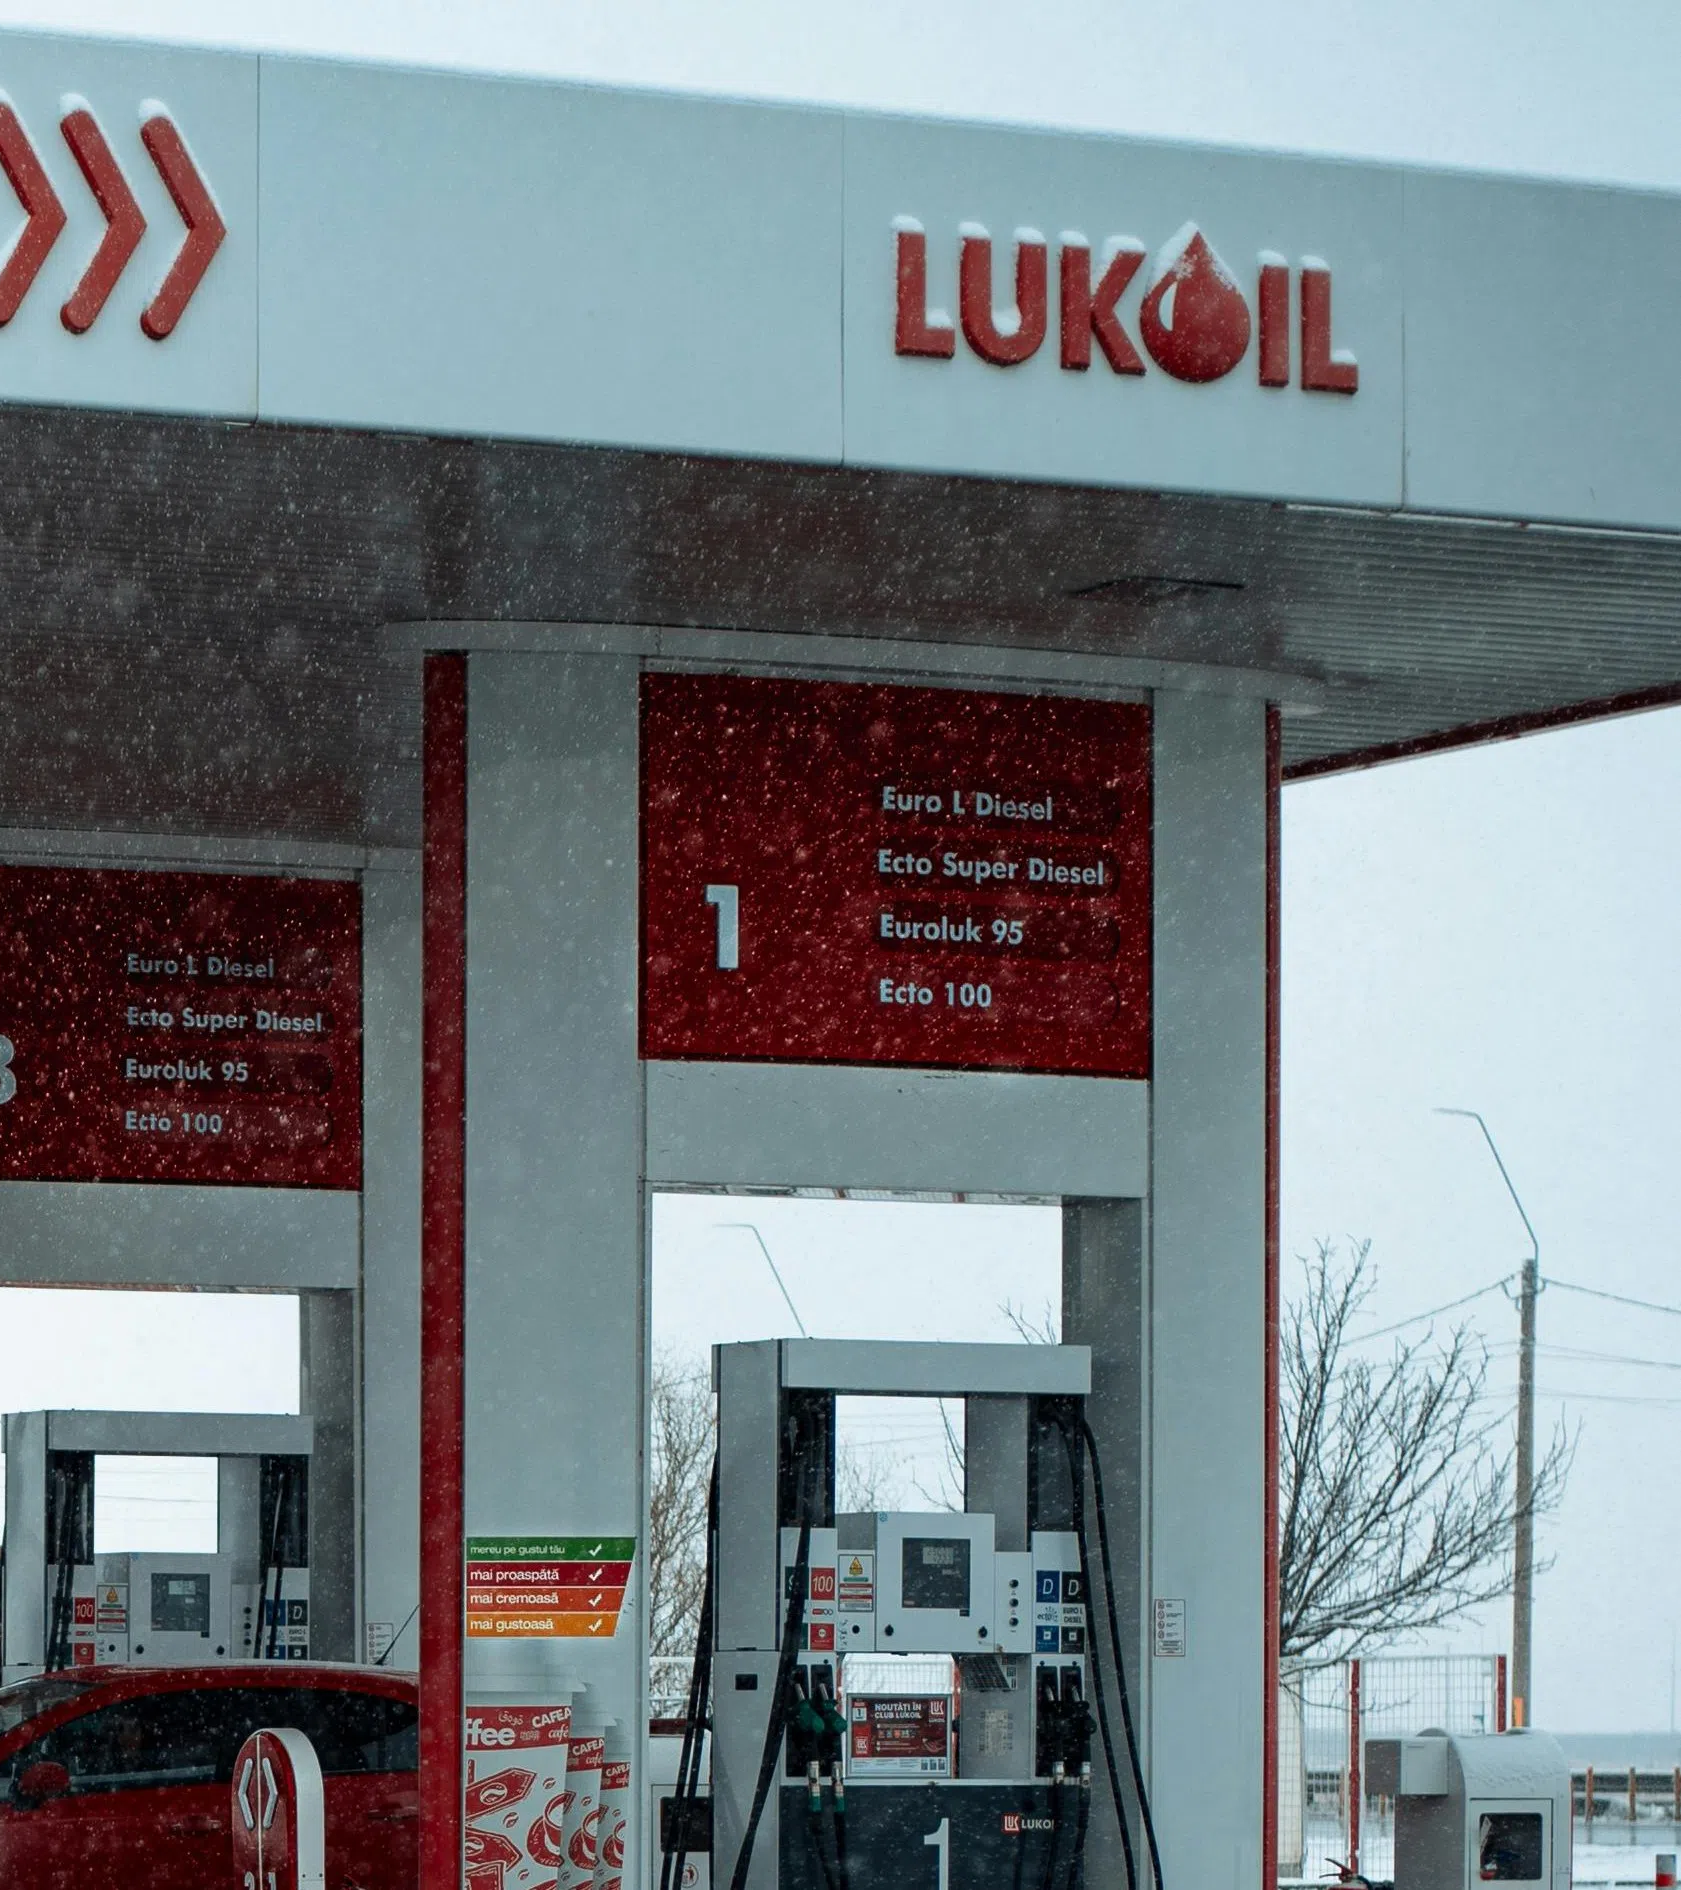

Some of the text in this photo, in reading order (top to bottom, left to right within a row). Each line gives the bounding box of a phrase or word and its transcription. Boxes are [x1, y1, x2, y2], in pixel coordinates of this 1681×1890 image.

[894, 217, 1359, 394] LUKOIL
[882, 786, 1054, 822] Euro L Diesel
[878, 849, 1105, 886] Ecto Super Diesel
[705, 884, 740, 970] 1
[880, 914, 1024, 946] Euroluk 95
[127, 953, 275, 979] Euro L Diesel
[880, 978, 992, 1009] Ecto 100
[126, 1006, 322, 1033] Ecto Super Diesel
[125, 1058, 249, 1083] Euroluk 95
[125, 1110, 222, 1135] Ecto 100
[470, 1545, 502, 1554] mereu
[503, 1545, 516, 1556] pe
[518, 1545, 549, 1556] gustul
[470, 1569, 560, 1582] mai proaspătă
[812, 1575, 834, 1593] 100
[1042, 1578, 1054, 1595] D
[1067, 1579, 1080, 1595] D
[470, 1592, 560, 1605] mai cremoasă
[76, 1604, 94, 1618] 100
[292, 1605, 303, 1620] D
[470, 1619, 555, 1633] mai gustoasă
[532, 1707, 572, 1729] CAFEA
[572, 1738, 606, 1756] CAFEA
[923, 1817, 949, 1890] 1
